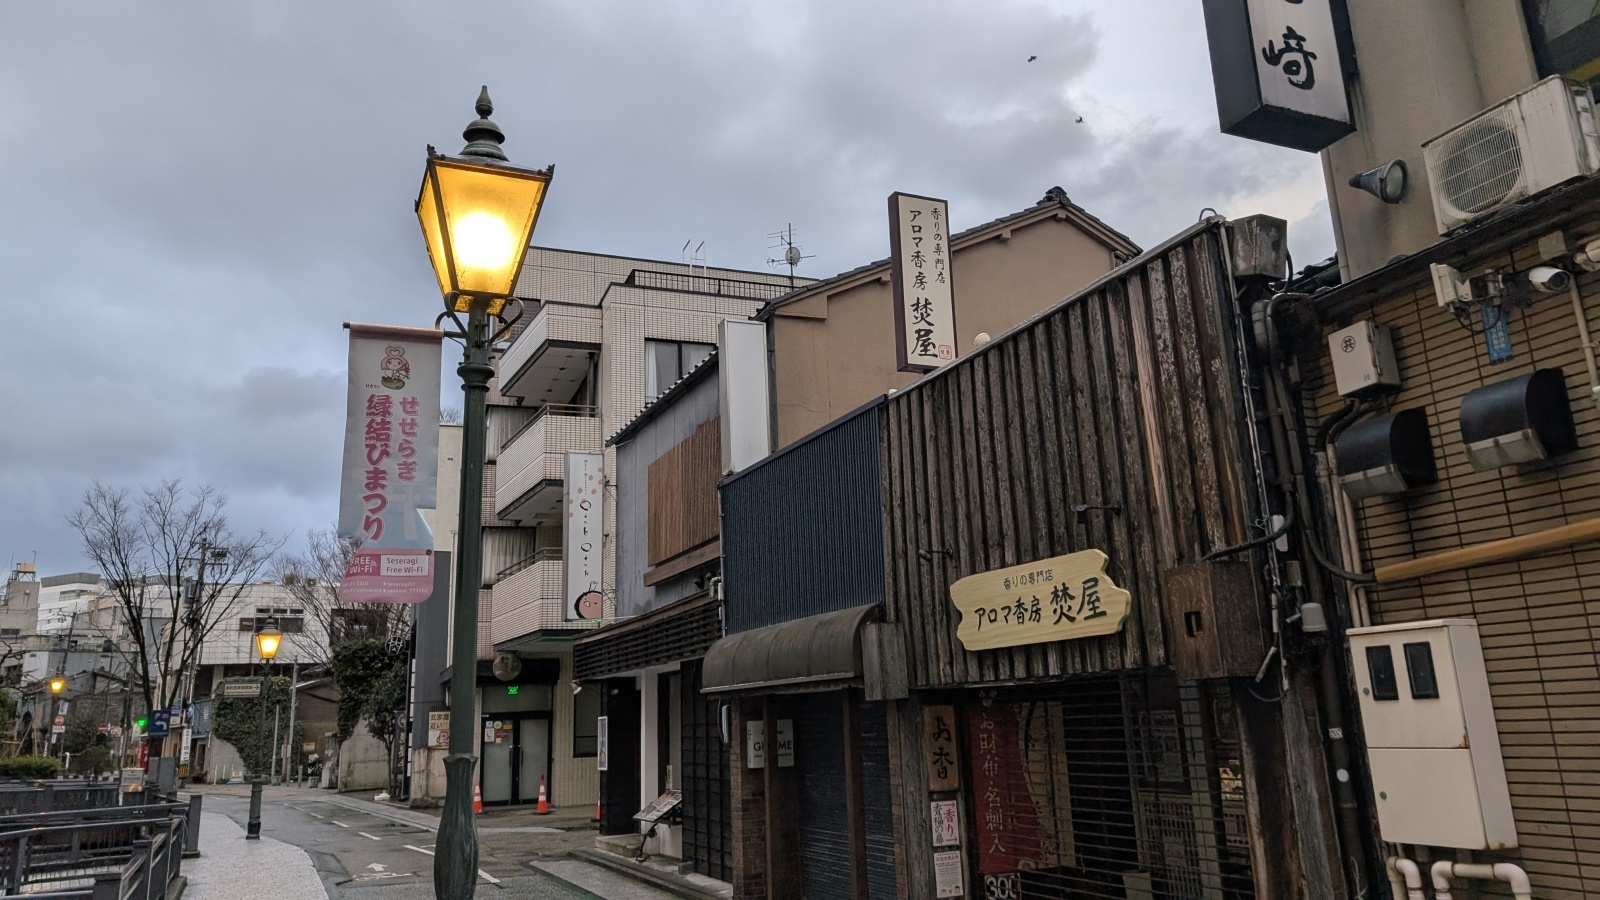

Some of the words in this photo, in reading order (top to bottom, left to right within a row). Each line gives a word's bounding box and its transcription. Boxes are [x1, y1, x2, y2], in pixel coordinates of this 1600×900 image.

[1261, 0, 1317, 90] 崎
[909, 209, 928, 291] アロマ香房
[930, 207, 946, 284] 香りの専門店
[909, 296, 939, 358] 焚屋
[362, 393, 394, 541] 縁結びまつり
[397, 396, 420, 482] せせらぎ
[386, 557, 418, 565] Seseragi
[386, 566, 403, 574] Free
[403, 566, 423, 574] Wi-Fi
[1003, 569, 1054, 590] 香りの専門店
[974, 595, 1042, 631] アロマ香房
[1050, 576, 1108, 626] 焚屋
[932, 715, 955, 779] お香
[943, 808, 956, 838] 香り
